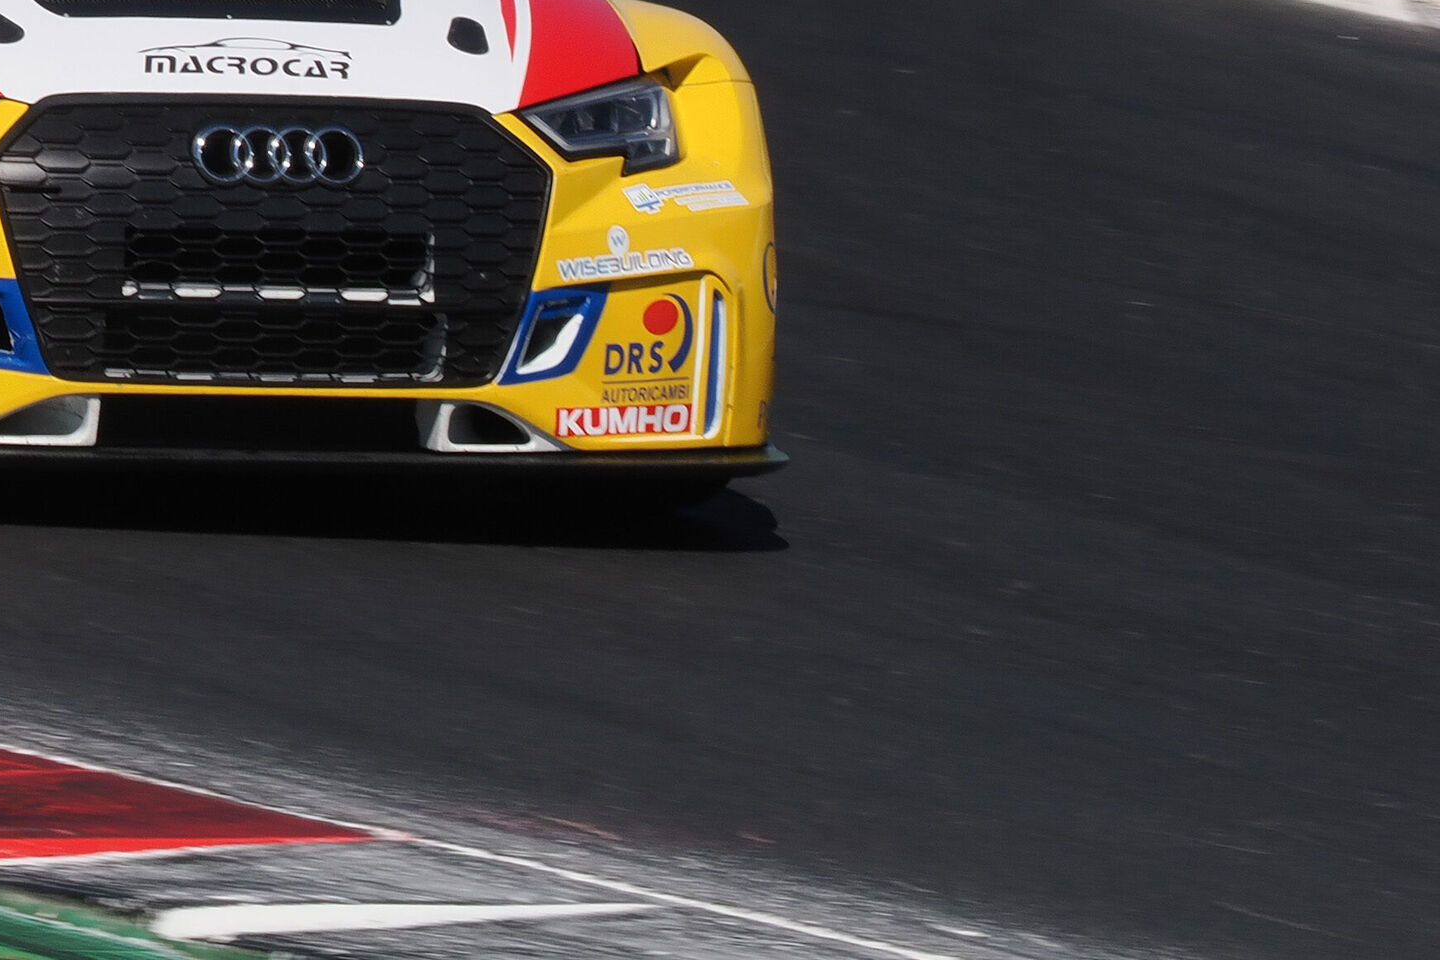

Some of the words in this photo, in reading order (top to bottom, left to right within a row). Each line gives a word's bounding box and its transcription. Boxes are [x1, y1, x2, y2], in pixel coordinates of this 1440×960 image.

[145, 54, 350, 79] MACROCAR
[558, 251, 691, 279] WISEBUILDING
[603, 341, 664, 375] DRS
[601, 385, 690, 403] AUTORICAMBI
[558, 404, 688, 436] KUMHO
